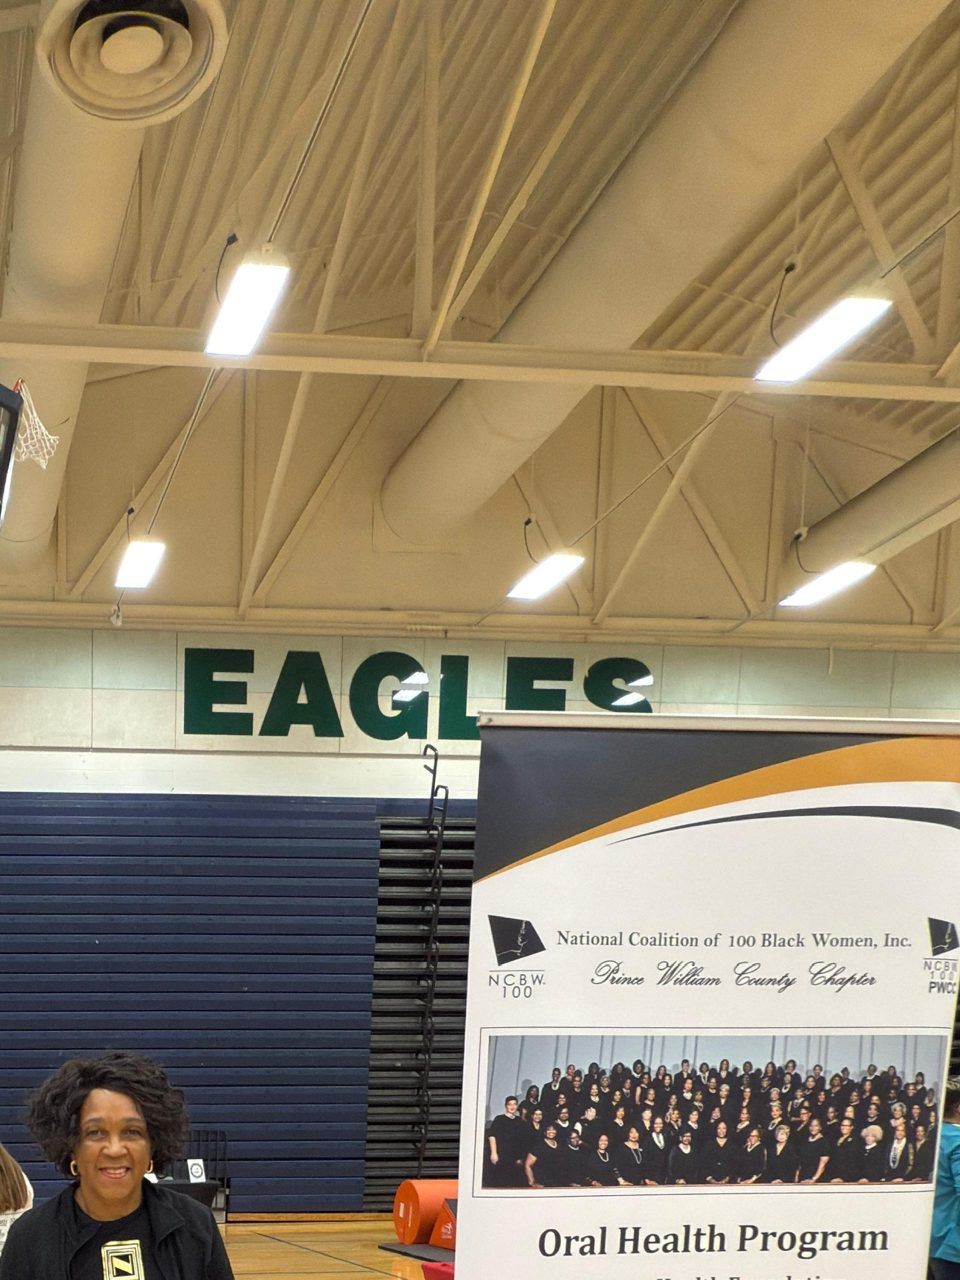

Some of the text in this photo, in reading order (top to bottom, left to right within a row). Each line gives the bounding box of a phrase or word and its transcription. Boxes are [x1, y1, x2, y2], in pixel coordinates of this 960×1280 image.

[183, 647, 653, 741] EAGLES
[557, 930, 912, 949] National Coalition of 100 Black Women, Inc.
[501, 986, 533, 999] 100
[590, 959, 877, 993] Prince William County Chapter
[538, 1224, 889, 1260] Oral Health Program
